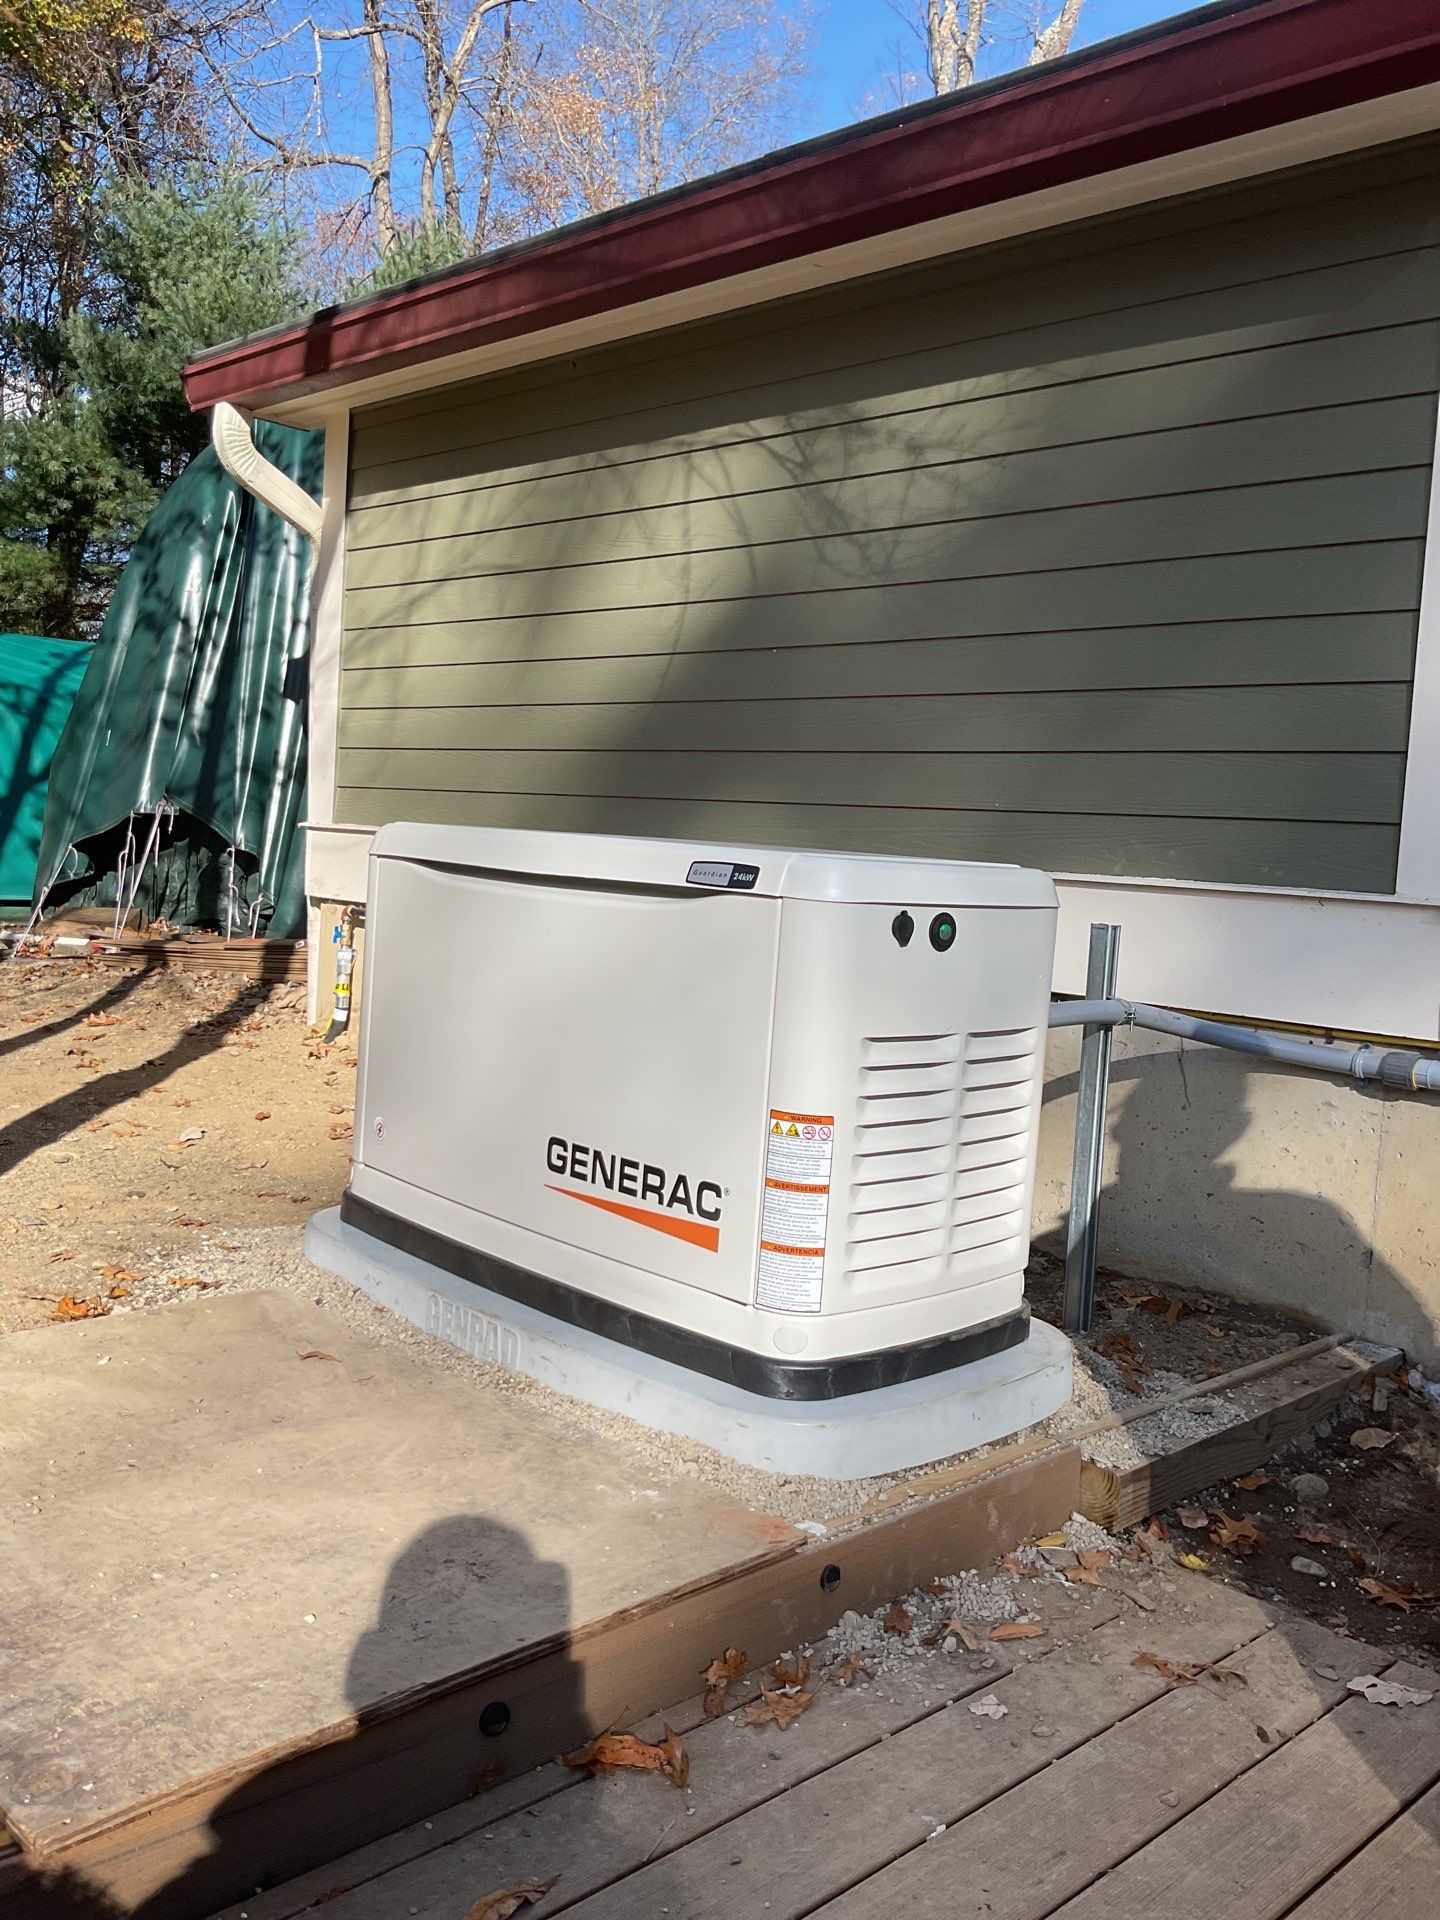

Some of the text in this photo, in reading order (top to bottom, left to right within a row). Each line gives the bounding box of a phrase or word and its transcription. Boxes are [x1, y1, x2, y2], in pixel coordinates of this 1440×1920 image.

[692, 870, 754, 881] Guardian 24kW
[790, 1115, 823, 1124] WARNING
[546, 1135, 723, 1222] GENERAC
[774, 1181, 828, 1192] AVERTISSEMENT
[773, 1245, 819, 1255] ADVERTENCIA
